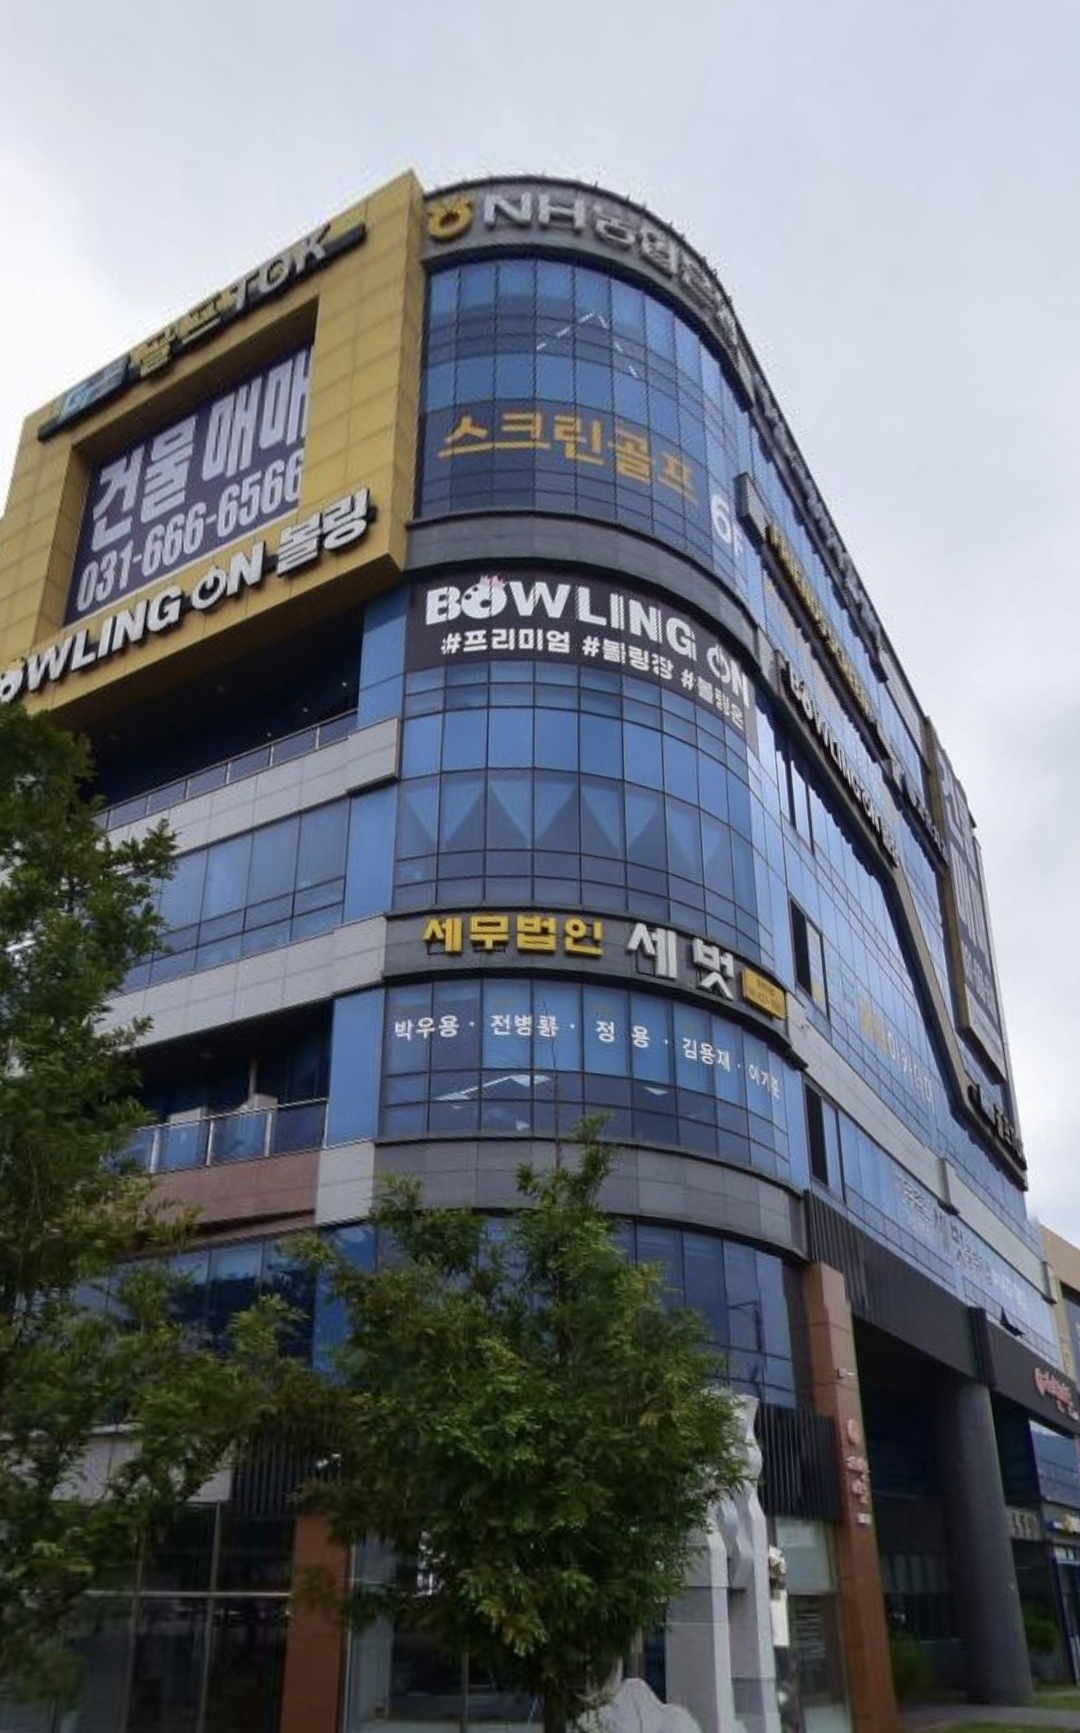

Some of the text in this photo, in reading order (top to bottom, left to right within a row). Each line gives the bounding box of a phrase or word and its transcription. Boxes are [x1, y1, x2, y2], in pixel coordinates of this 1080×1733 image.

[92, 413, 197, 552] 건물
[202, 350, 309, 482] 매매
[437, 411, 697, 503] 스크린골프
[76, 449, 305, 613] 031-666-6566
[191, 540, 266, 610] ON
[277, 488, 371, 576] 볼링
[425, 576, 750, 710] BOWLING ON
[440, 628, 571, 655] #프리미엄
[582, 635, 674, 680] #볼링장
[422, 914, 603, 956] 세무법인
[394, 1015, 460, 1041] 박우용
